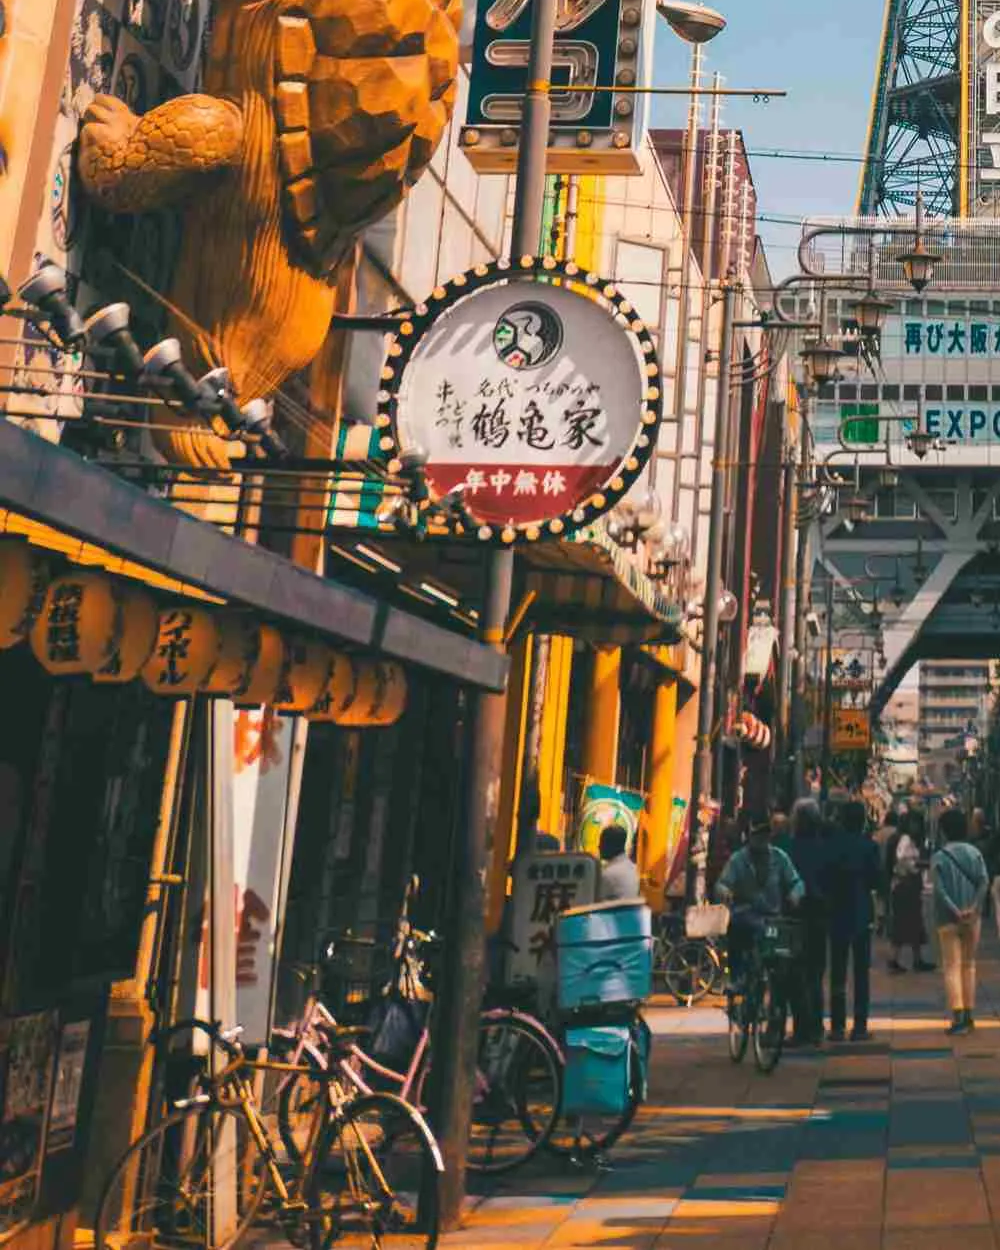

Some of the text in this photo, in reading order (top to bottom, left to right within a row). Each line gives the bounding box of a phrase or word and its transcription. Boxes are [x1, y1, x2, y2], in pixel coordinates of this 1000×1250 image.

[436, 379, 455, 428] 串かつ
[472, 400, 603, 450] 鶴亀家
[464, 468, 567, 497] 年中無休
